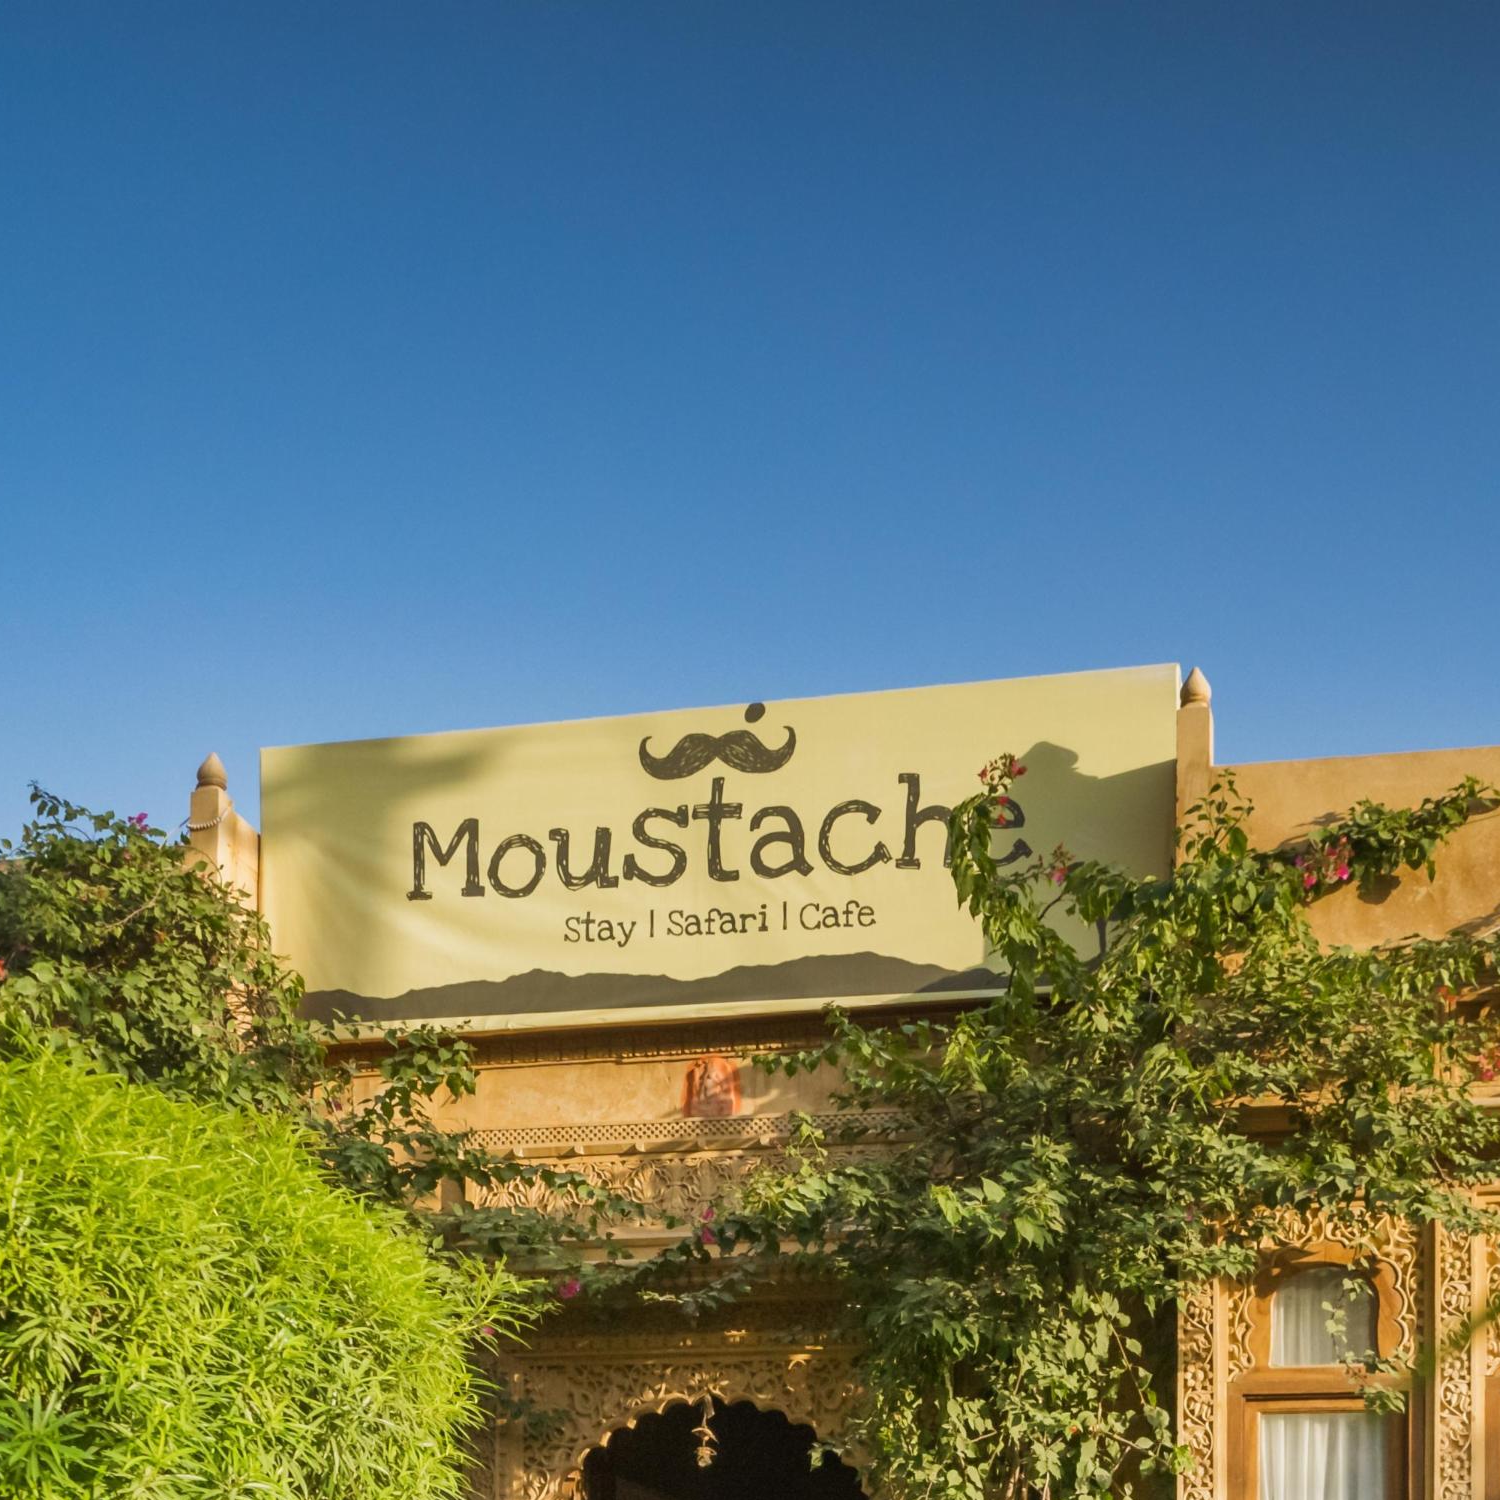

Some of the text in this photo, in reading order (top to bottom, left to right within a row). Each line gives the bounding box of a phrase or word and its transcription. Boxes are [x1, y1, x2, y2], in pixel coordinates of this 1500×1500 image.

[564, 911, 637, 947] Stay
[667, 903, 769, 936] Safari
[800, 900, 877, 930] Cafe
